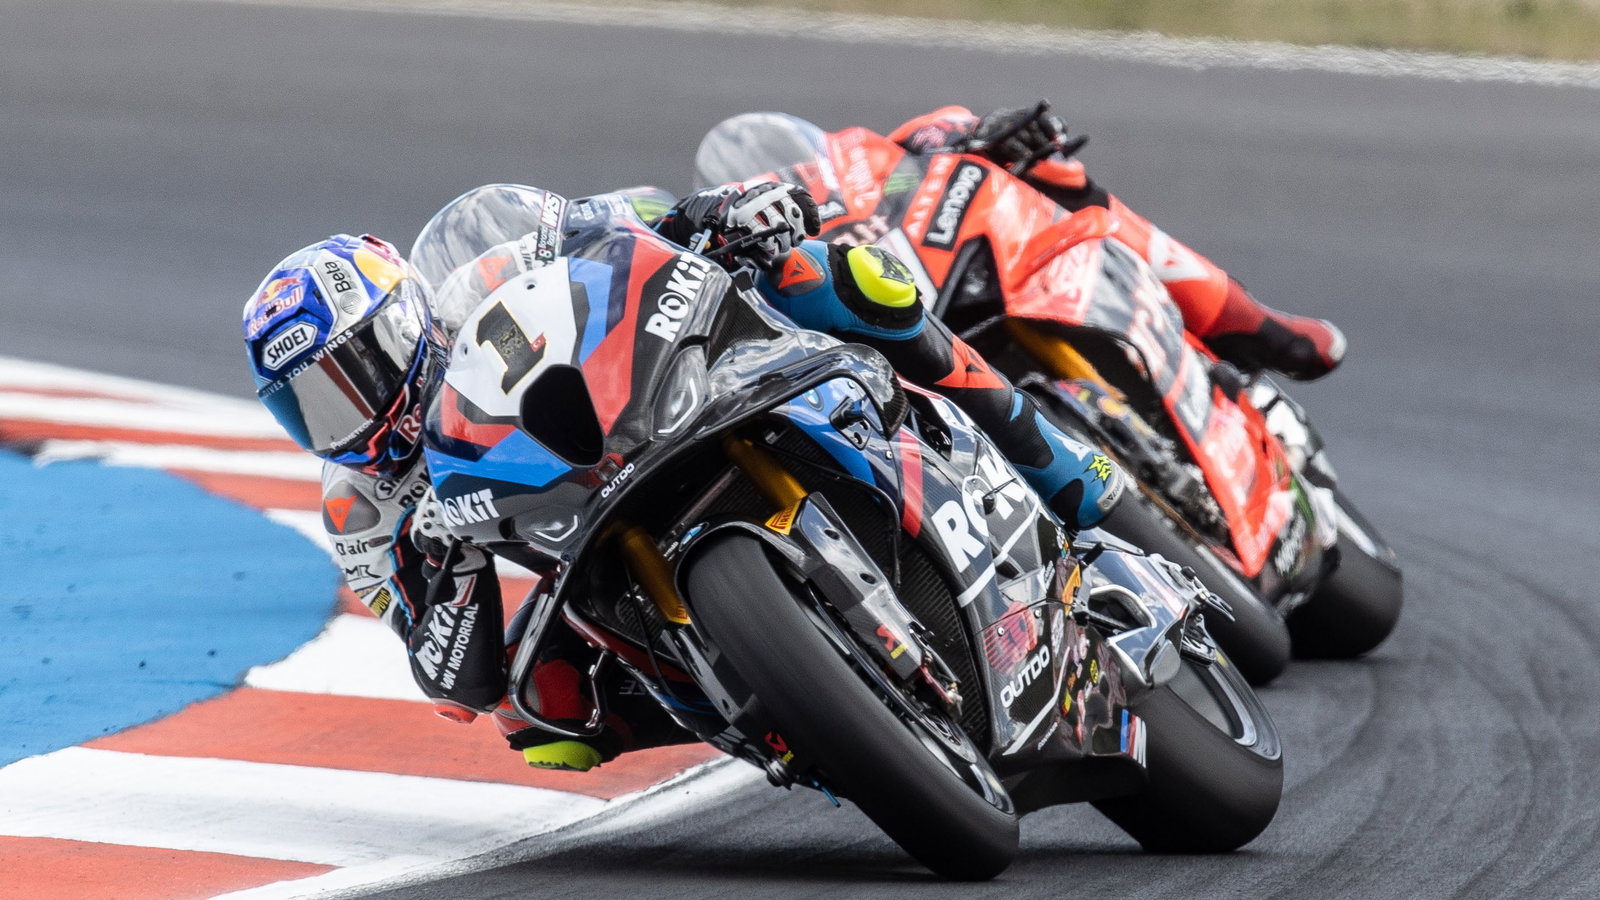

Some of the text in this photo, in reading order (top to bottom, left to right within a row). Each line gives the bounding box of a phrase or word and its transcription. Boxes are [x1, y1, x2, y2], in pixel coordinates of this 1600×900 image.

[927, 165, 982, 245] Lenovo
[271, 286, 304, 316] Bull
[325, 261, 352, 293] Beta
[644, 251, 712, 343] ROKiT
[267, 327, 308, 364] SHOEI
[285, 361, 309, 380] YOU
[312, 329, 354, 362] WINGS
[475, 300, 547, 395] 1
[601, 463, 635, 498] OUTDO
[1000, 644, 1050, 708] OUTDO
